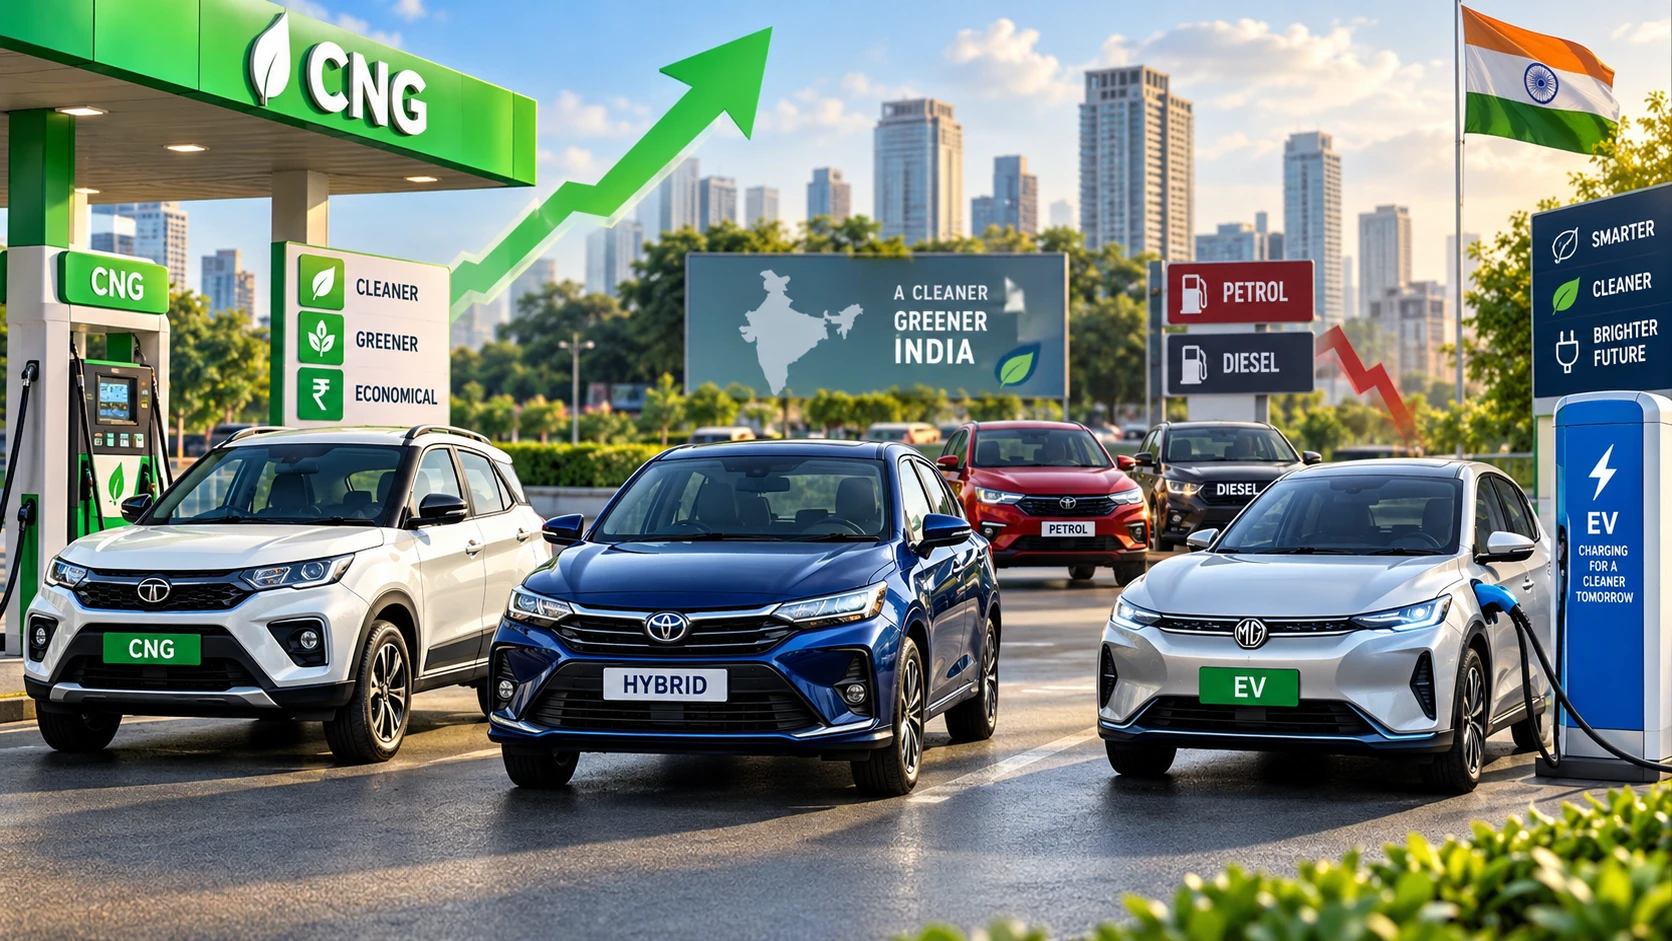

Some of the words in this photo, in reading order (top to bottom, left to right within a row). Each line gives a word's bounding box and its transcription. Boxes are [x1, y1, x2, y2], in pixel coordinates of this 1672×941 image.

[307, 41, 428, 136] CNG
[1591, 219, 1655, 248] SMARTER
[91, 266, 144, 301] CNG
[356, 278, 419, 302] CLEANER
[893, 284, 905, 301] A
[912, 284, 988, 301] CLEANER
[1223, 280, 1289, 303] PETROL
[1592, 271, 1652, 298] CLEANER
[894, 310, 988, 332] GREENER
[1593, 319, 1658, 344] BRIGHTER
[356, 330, 418, 353] GREENER
[895, 338, 975, 365] INDIA
[1223, 352, 1280, 374] DIESEL
[1593, 344, 1647, 367] FUTURE
[355, 384, 438, 406] ECONOMICAL
[1216, 482, 1259, 496] DIESEL
[1048, 523, 1089, 535] PETROL
[1587, 511, 1619, 535] EV
[1578, 544, 1629, 557] CHARGING
[1589, 560, 1608, 572] FOR
[1610, 560, 1618, 572] A
[1582, 575, 1626, 588] CLEANER
[1575, 591, 1634, 603] TOMORROW
[1237, 622, 1264, 645] MG
[128, 638, 175, 659] CNG
[623, 674, 708, 695] HYBRID
[1234, 675, 1267, 698] EV
